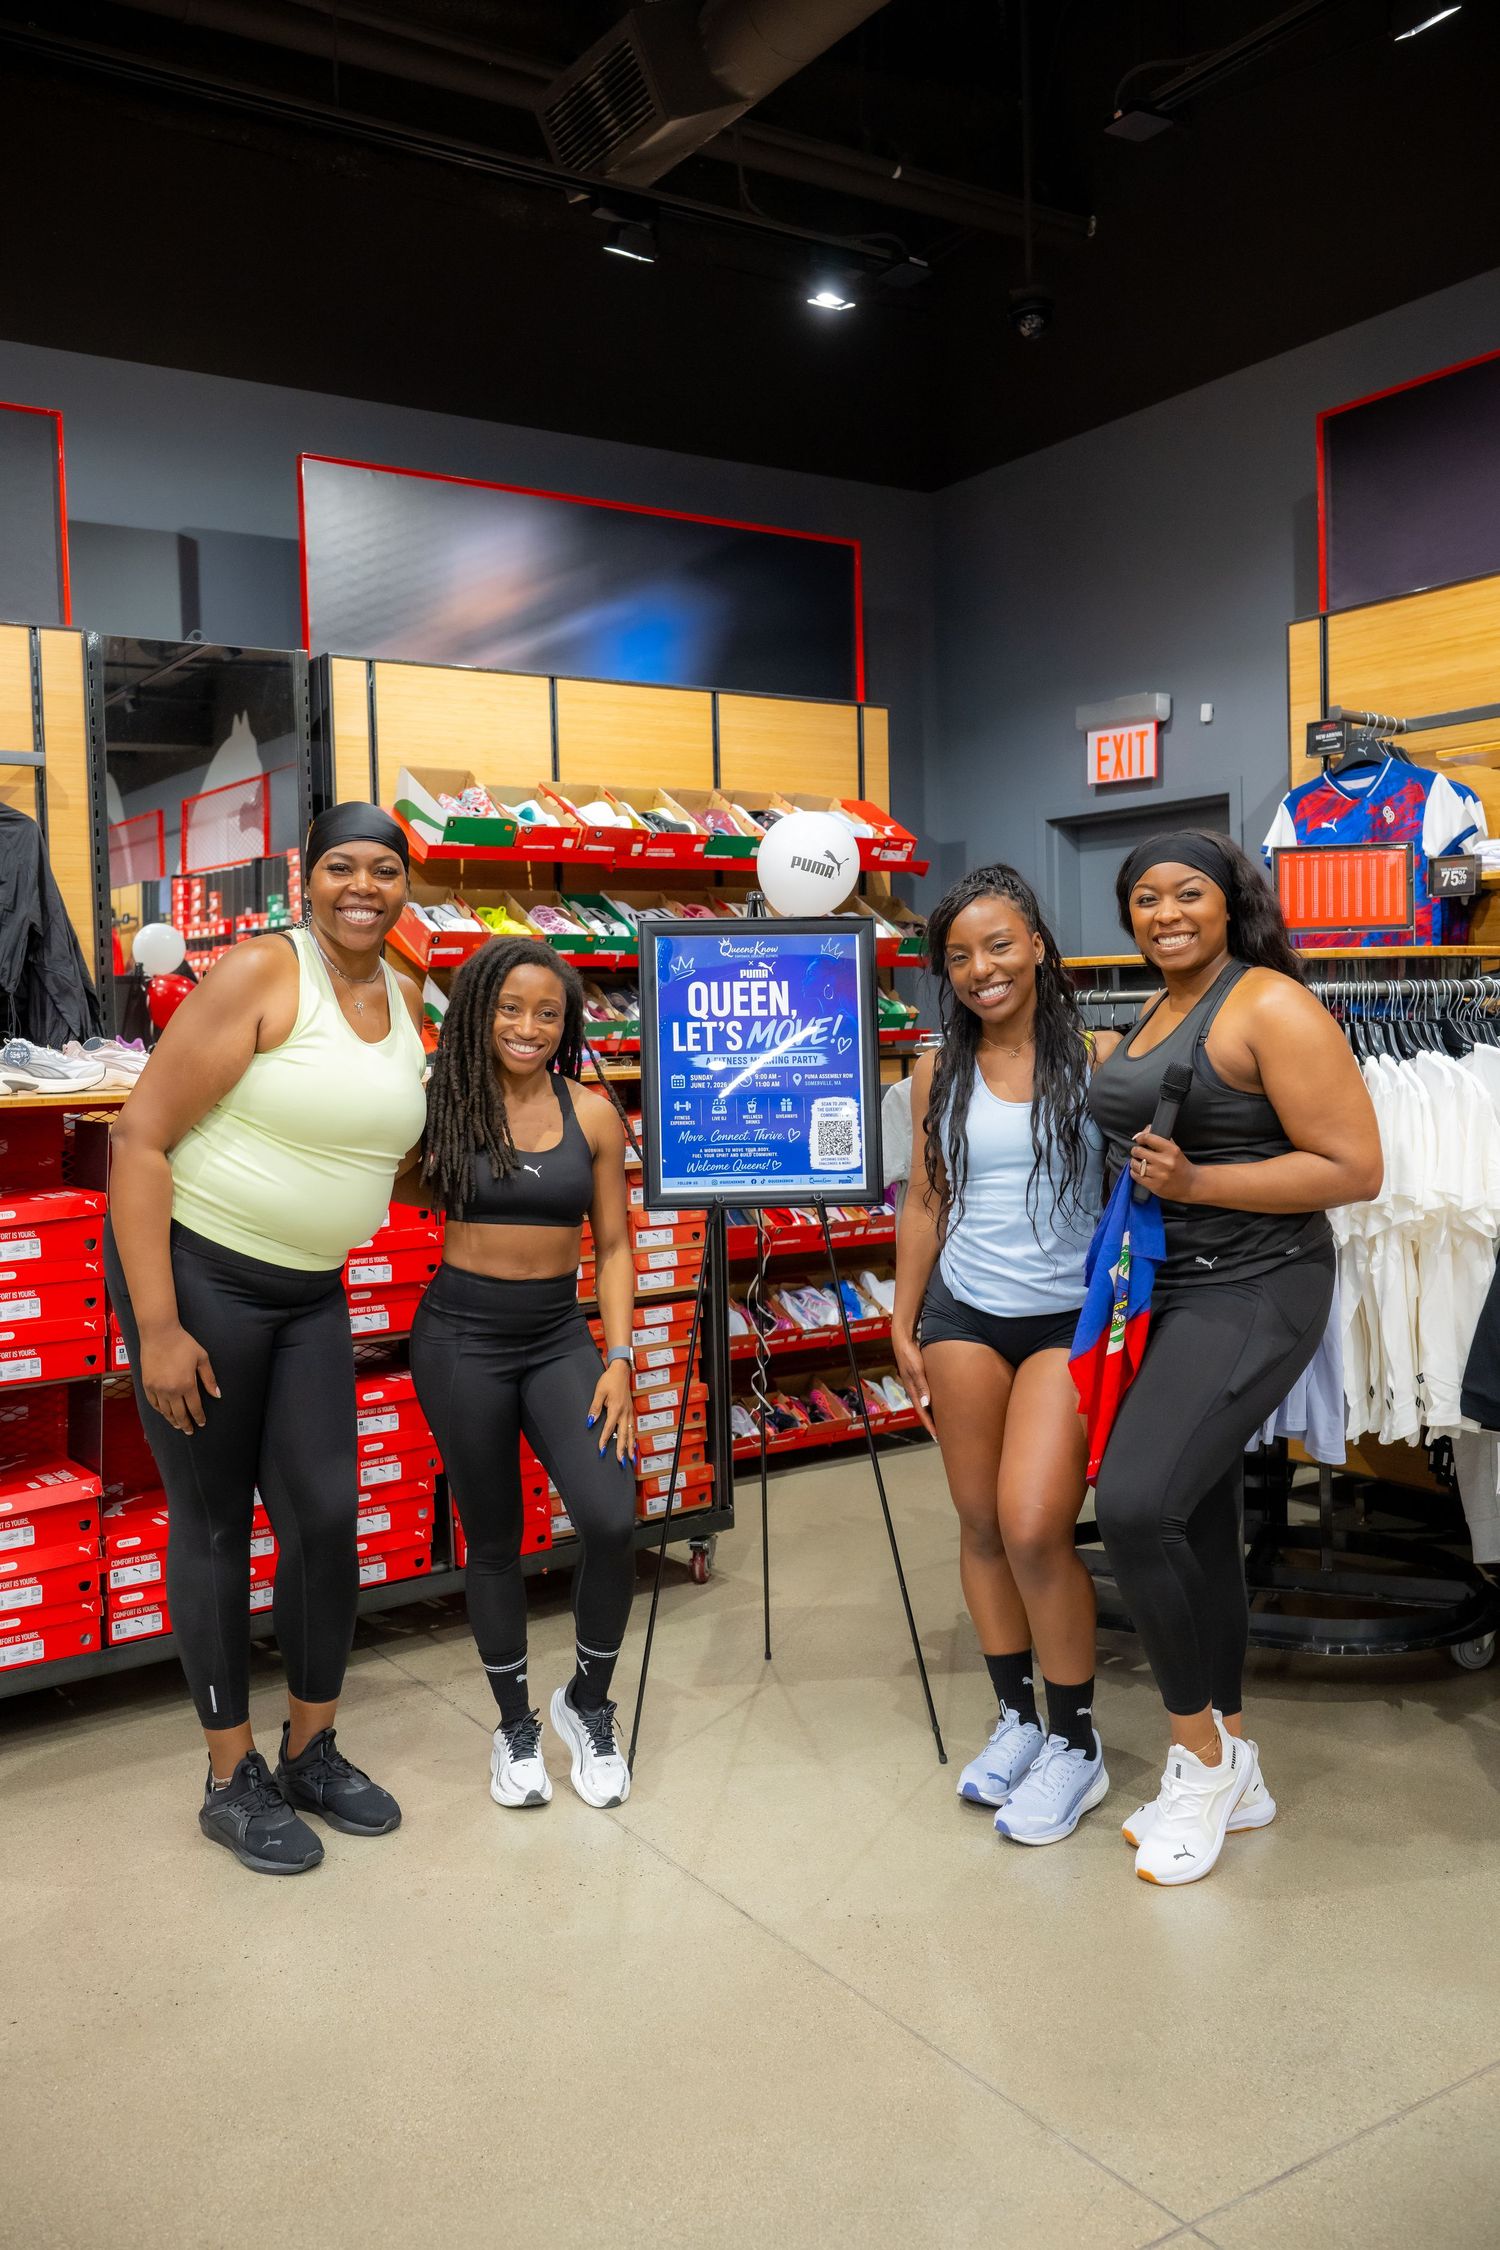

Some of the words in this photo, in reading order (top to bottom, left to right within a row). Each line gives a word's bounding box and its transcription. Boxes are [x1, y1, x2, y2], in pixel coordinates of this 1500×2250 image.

[1097, 730, 1149, 781] EXIT
[791, 856, 835, 879] PUMA
[1441, 870, 1467, 887] 75%
[719, 939, 779, 958] QueensKnow
[740, 968, 769, 979] PUMA
[687, 980, 798, 1021] QUEEN,
[672, 1021, 743, 1052] LET'S
[746, 1014, 844, 1051] MOVE!
[792, 1055, 818, 1065] PARTY
[677, 1130, 707, 1144] Move.
[710, 1129, 751, 1143] Connect.
[753, 1128, 785, 1142] Thrive.
[687, 1160, 731, 1173] Welcome
[732, 1159, 771, 1172] Queens!
[18, 1230, 37, 1239] YOURS.
[111, 1556, 135, 1567] COMFORT
[134, 1555, 140, 1563] IS
[140, 1553, 158, 1562] YOURS.
[13, 1579, 19, 1587] IS
[19, 1576, 39, 1586] YOURS.
[112, 1608, 136, 1619] COMFORT
[142, 1603, 160, 1613] YOURS.
[15, 1634, 21, 1642] IS
[21, 1631, 40, 1641] YOURS.
